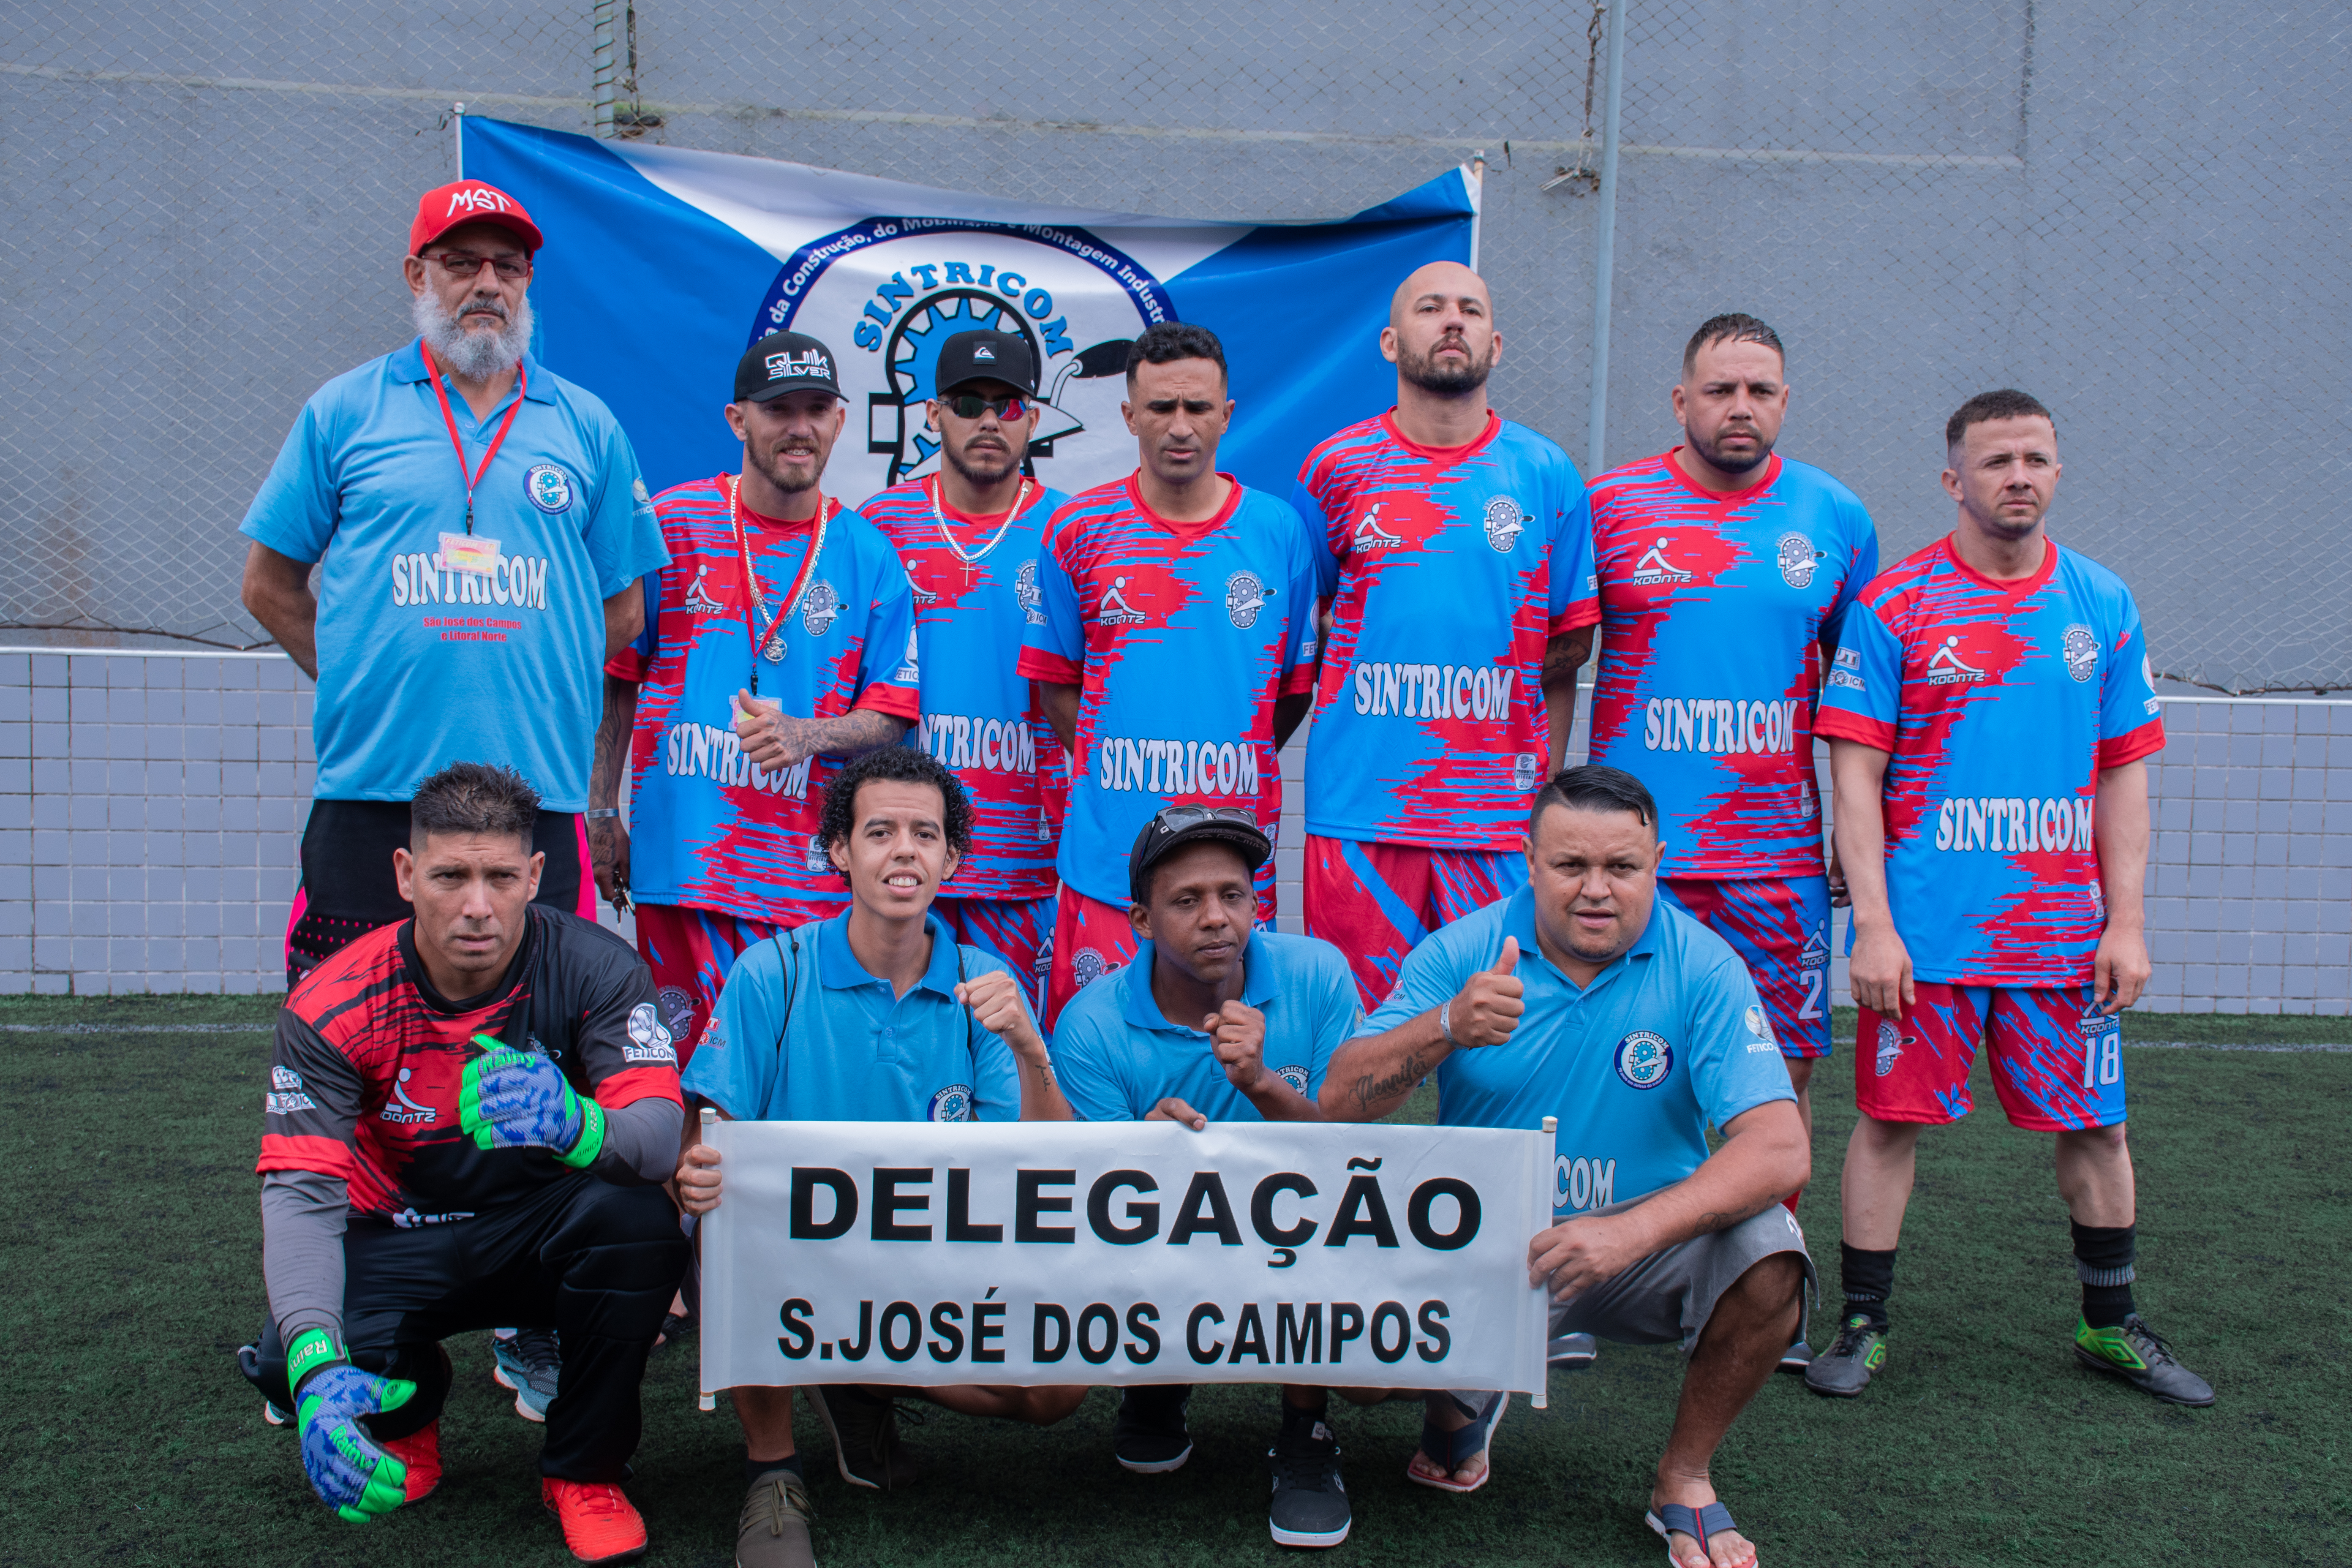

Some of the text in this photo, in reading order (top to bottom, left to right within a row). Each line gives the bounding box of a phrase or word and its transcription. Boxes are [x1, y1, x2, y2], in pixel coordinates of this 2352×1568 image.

[446, 188, 511, 218] MST
[769, 298, 791, 324] da
[783, 235, 871, 297] Construção,
[873, 223, 898, 238] do
[1023, 224, 1119, 270] Montagem
[853, 261, 1073, 360] SINTRICOM
[392, 553, 549, 611] SINTRICOM
[1633, 573, 1692, 586] KOONTZ
[424, 617, 522, 629] São José dos Campos
[441, 631, 507, 642] e Litoral Norte
[1036, 613, 1048, 624] ICM
[1100, 614, 1146, 627] KOONTZ
[1354, 662, 1515, 721] SINTRICOM
[1927, 673, 1985, 686] KOONTZ
[915, 713, 1036, 774] NTRICOM
[1644, 697, 1798, 755] SINTRICOM
[1100, 736, 1260, 796] SINTRICOM
[1935, 797, 2093, 853] SINTRICOM
[710, 1036, 727, 1048] ICM
[1625, 1031, 1670, 1049] SINTRICOM
[2084, 1032, 2120, 1089] 18
[935, 1084, 972, 1101] SINTRICOM
[576, 1138, 600, 1158] JUNIOR
[789, 1157, 1481, 1268] DELEGAÇÃO
[777, 1286, 1450, 1365] S.JOSÉ DOS CAMPOS
